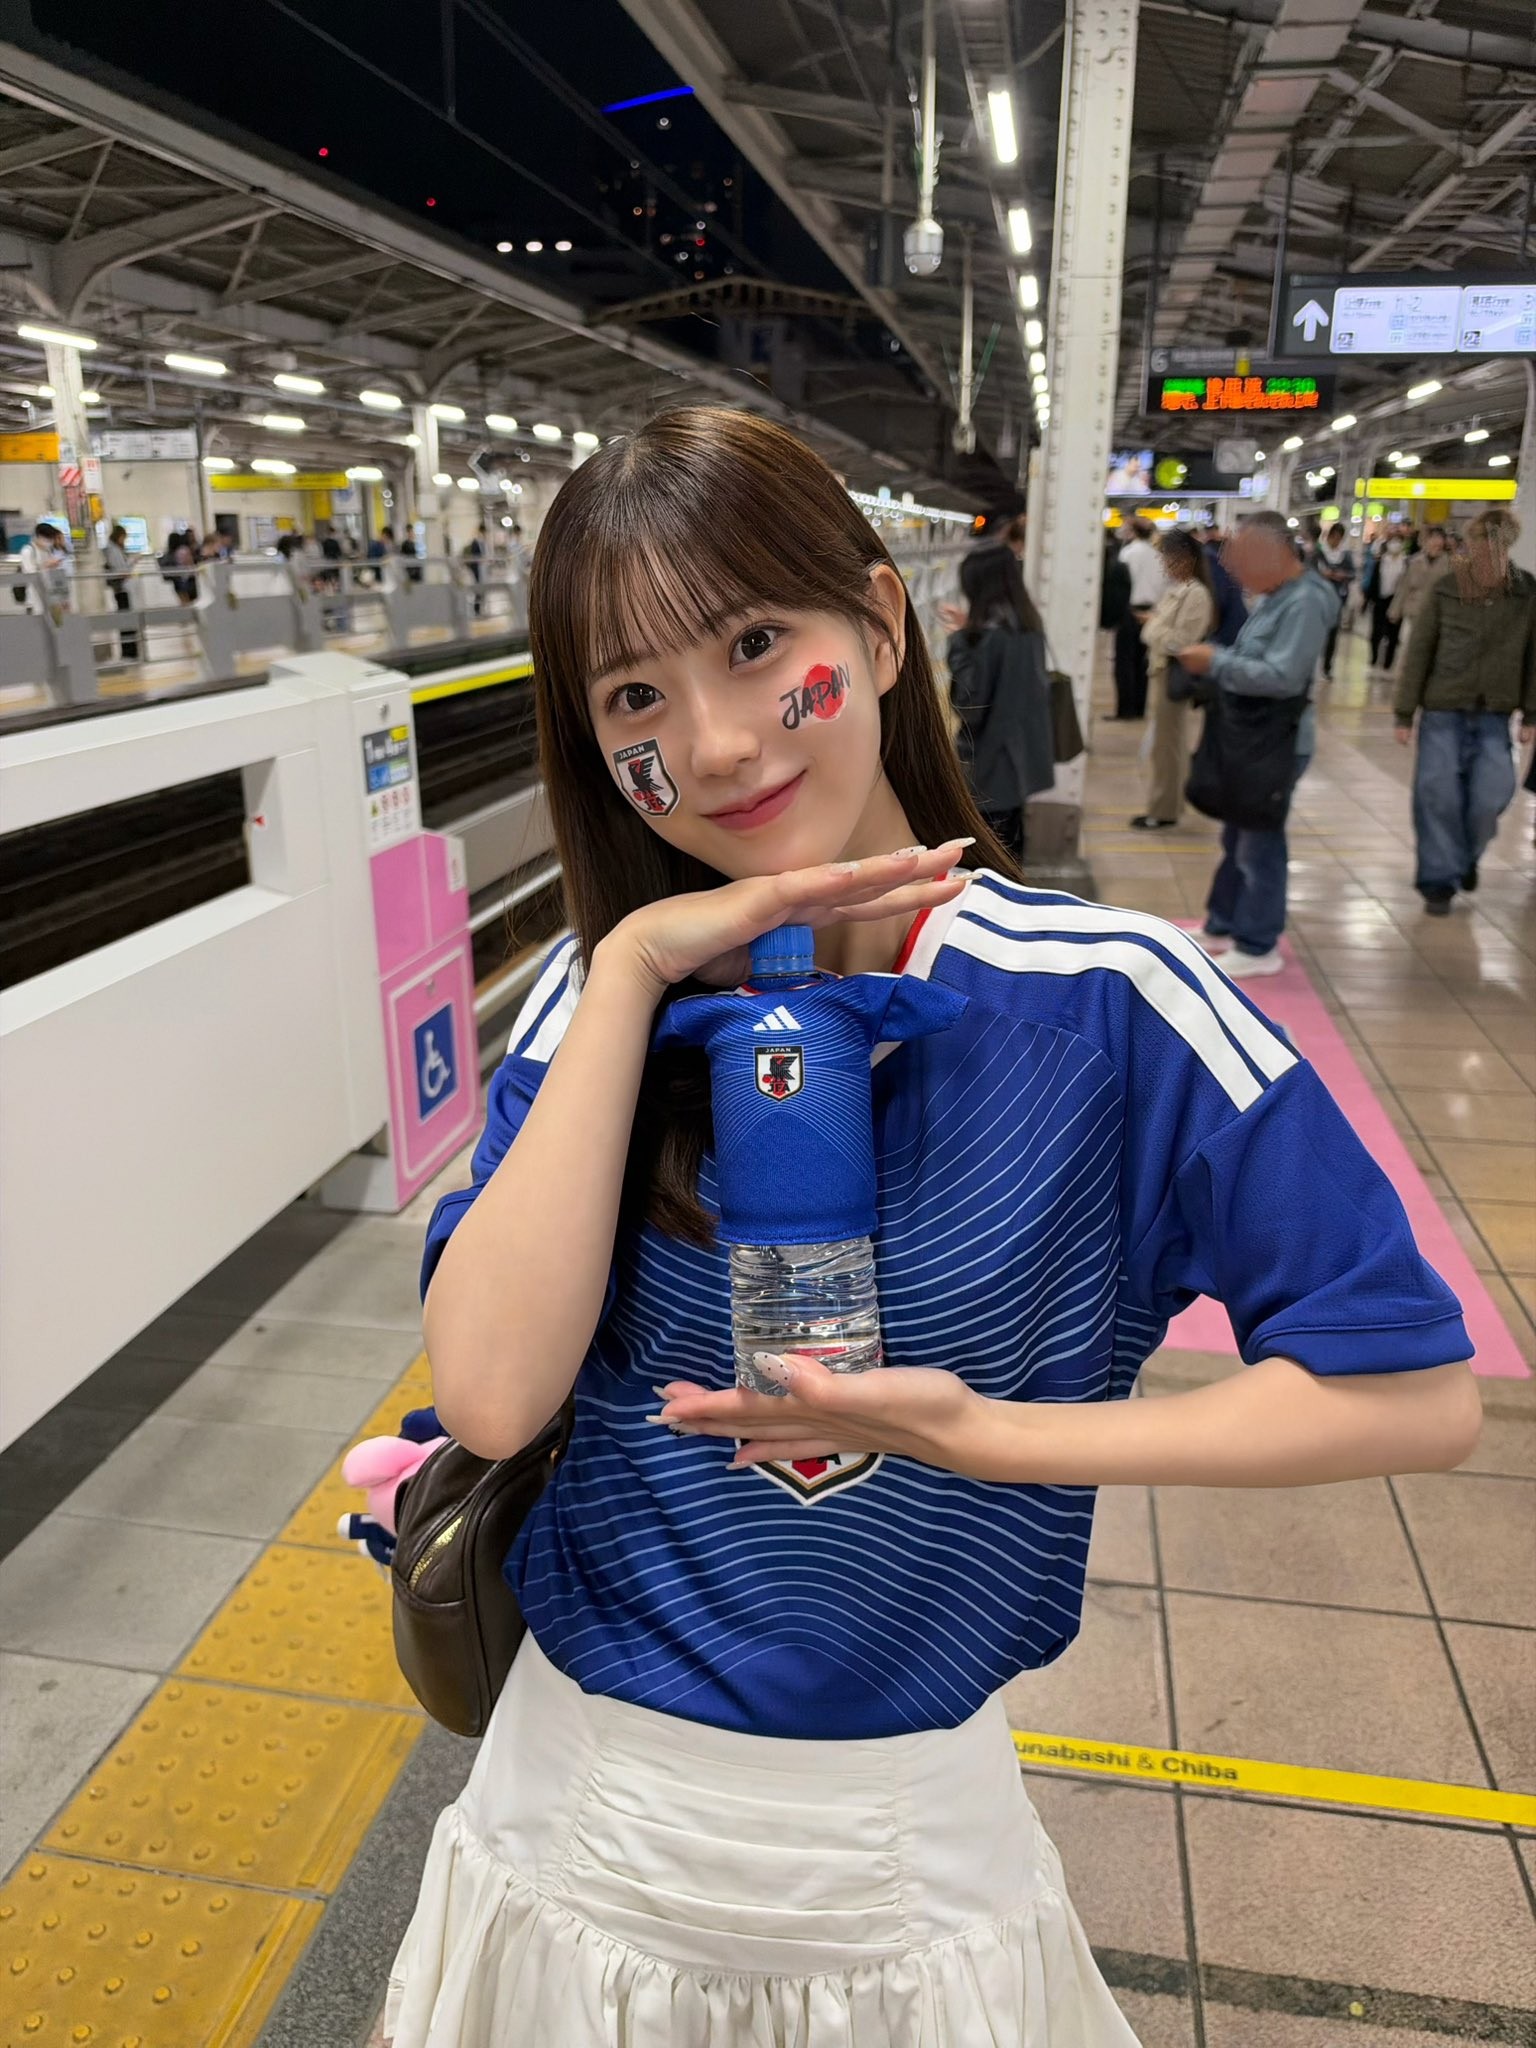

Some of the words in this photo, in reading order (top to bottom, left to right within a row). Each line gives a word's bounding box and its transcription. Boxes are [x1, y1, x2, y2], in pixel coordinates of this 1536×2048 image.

[1151, 350, 1169, 373] 6
[778, 661, 852, 730] JAPAN
[618, 745, 645, 760] JAPAN
[767, 1083, 791, 1093] JFA
[1137, 1753, 1155, 1770] &
[1161, 1756, 1239, 1781] Chiba
